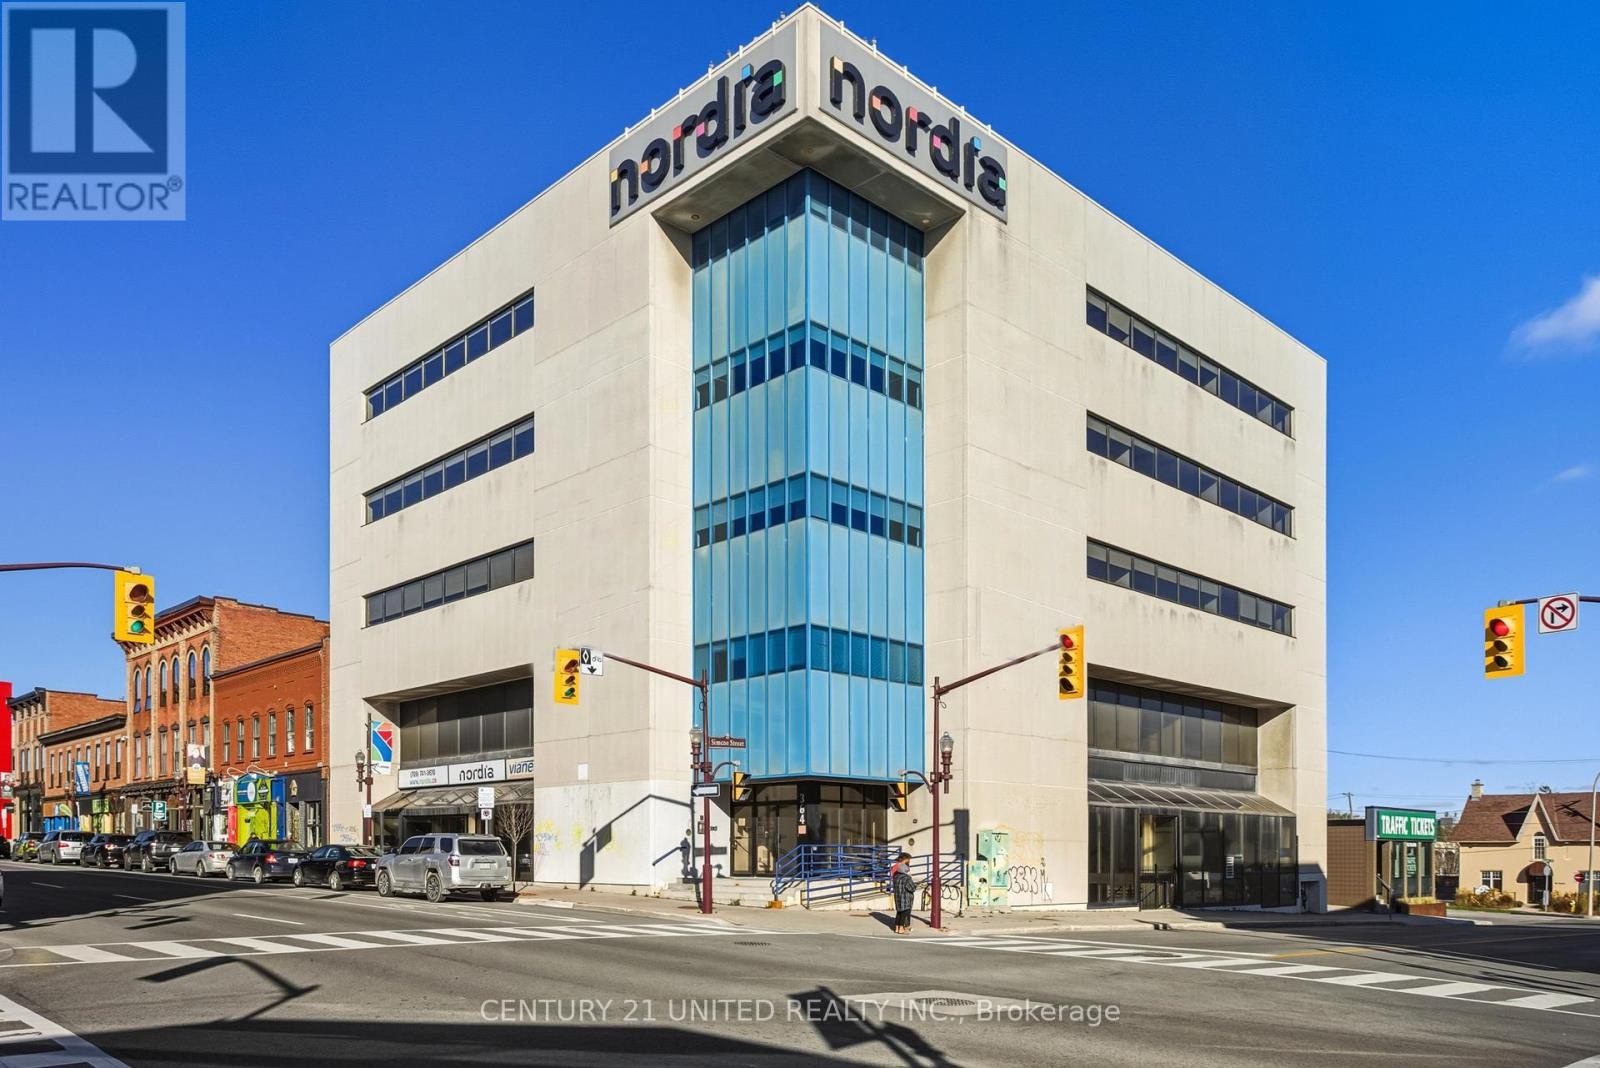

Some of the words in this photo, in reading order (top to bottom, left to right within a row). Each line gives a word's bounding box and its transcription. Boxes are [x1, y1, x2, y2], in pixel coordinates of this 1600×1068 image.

[611, 59, 786, 217] nordia
[829, 56, 1007, 212] nordia
[459, 764, 494, 781] nordia
[1381, 815, 1408, 835] TRAFFIC
[1410, 817, 1435, 836] TICKETS
